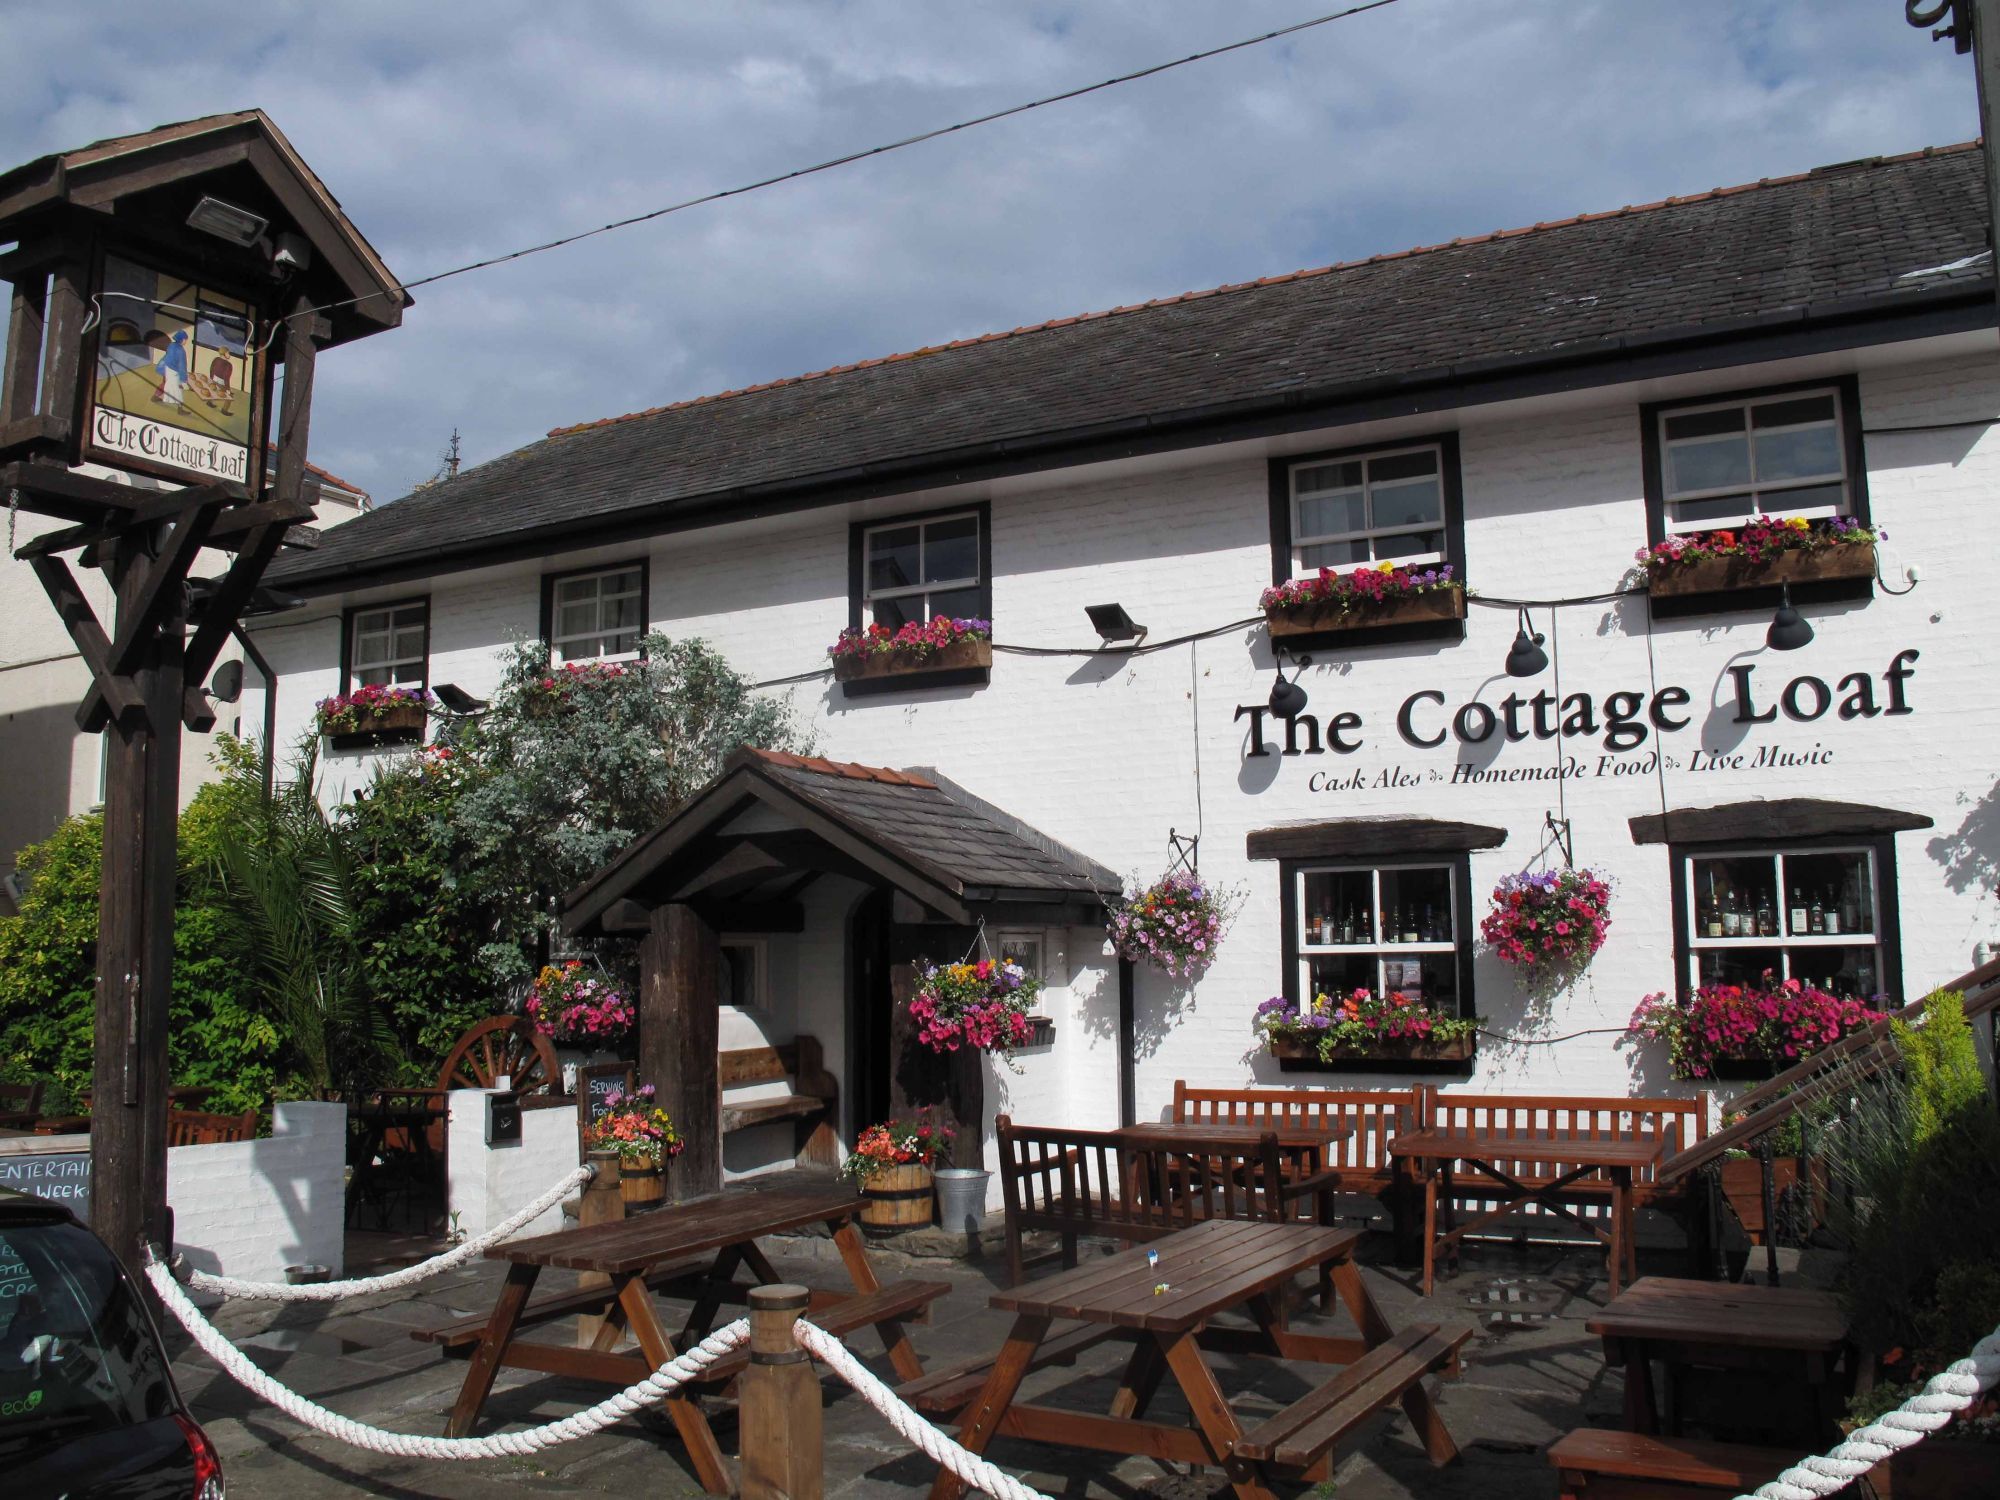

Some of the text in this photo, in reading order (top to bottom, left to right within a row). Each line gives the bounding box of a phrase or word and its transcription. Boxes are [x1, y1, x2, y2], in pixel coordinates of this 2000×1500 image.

[97, 409, 246, 480] The Cottage Loaf
[1233, 649, 1920, 758] The Cottage Loaf
[1308, 742, 1833, 792] Cask Ales Homemade Food Live Music
[0, 1160, 91, 1180] ENTERTAI
[36, 1183, 90, 1200] WEEK
